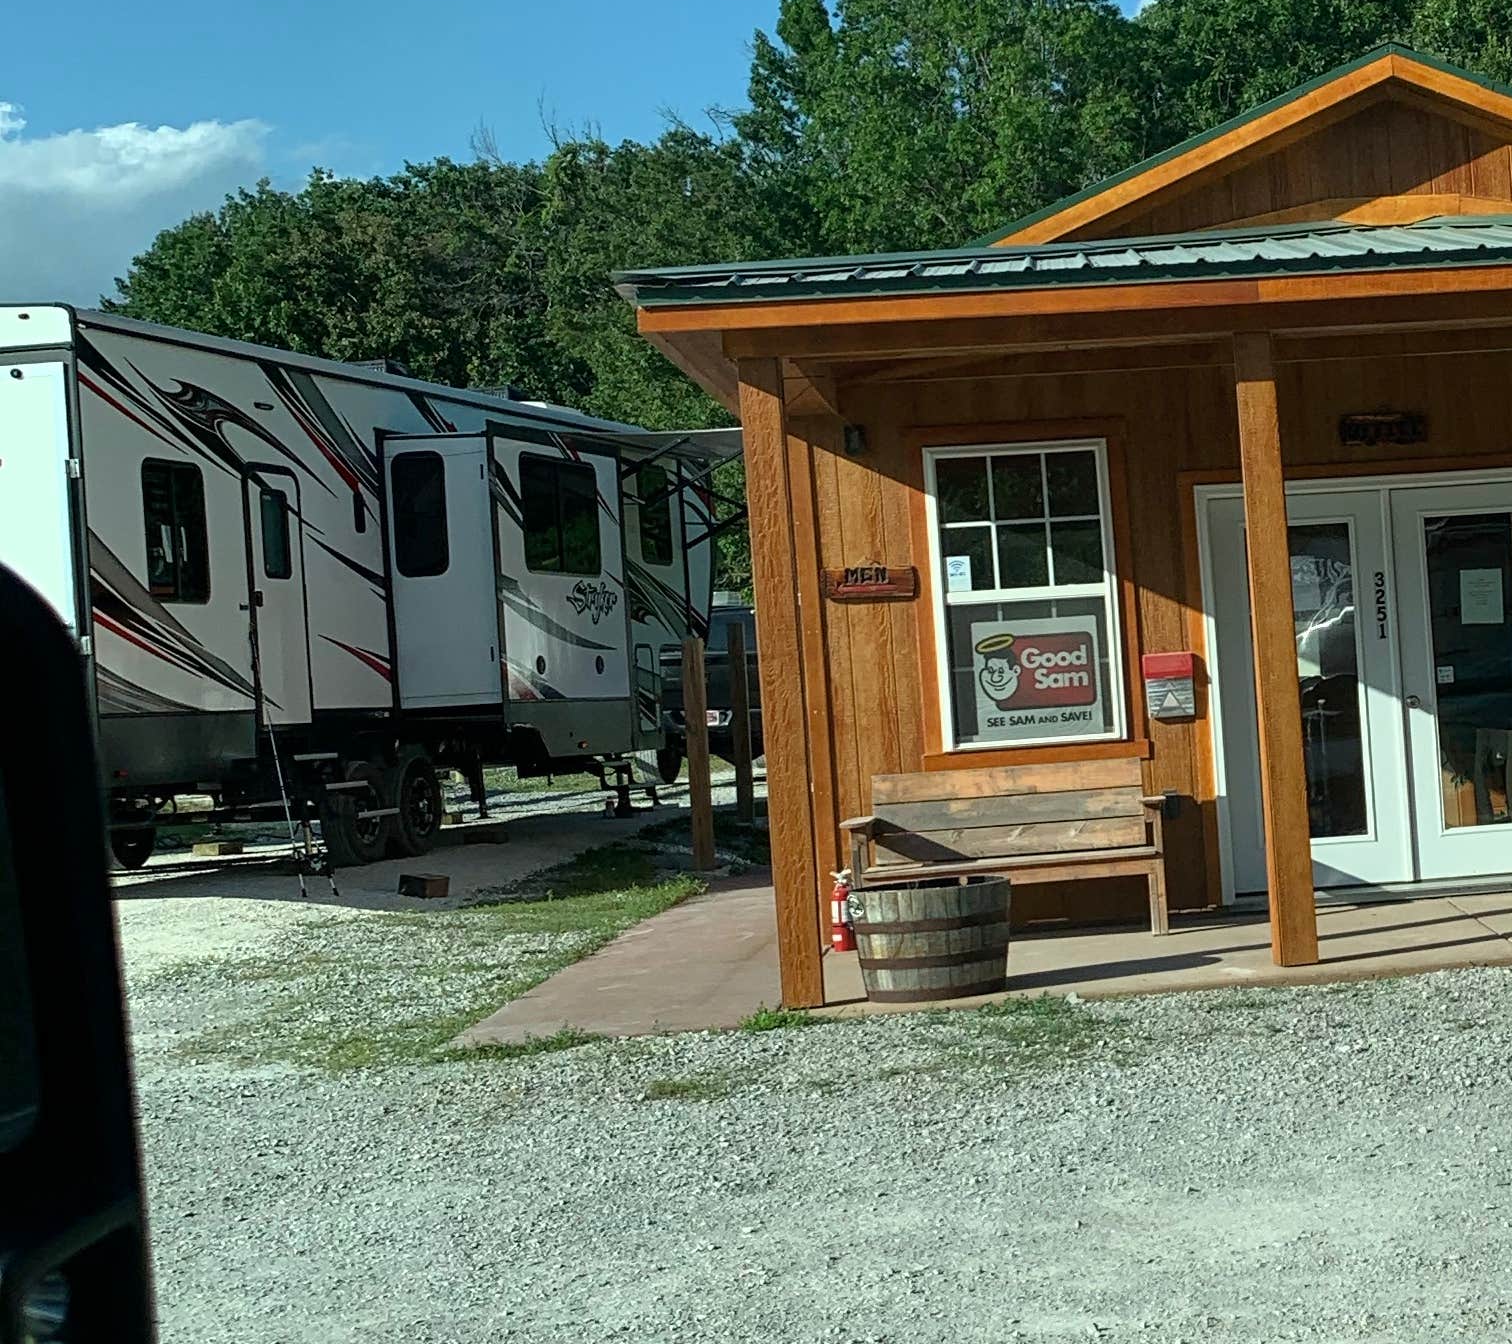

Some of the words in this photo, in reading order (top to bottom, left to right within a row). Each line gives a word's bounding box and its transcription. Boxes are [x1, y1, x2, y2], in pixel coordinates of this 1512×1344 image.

[843, 565, 889, 585] MEN
[1374, 571, 1388, 639] 3251
[1020, 644, 1088, 669] Good
[1034, 667, 1089, 690] Sam
[987, 716, 1006, 728] SEE
[1009, 714, 1036, 726] SAM
[1038, 716, 1059, 724] AND
[1060, 710, 1092, 722] SAVE!
